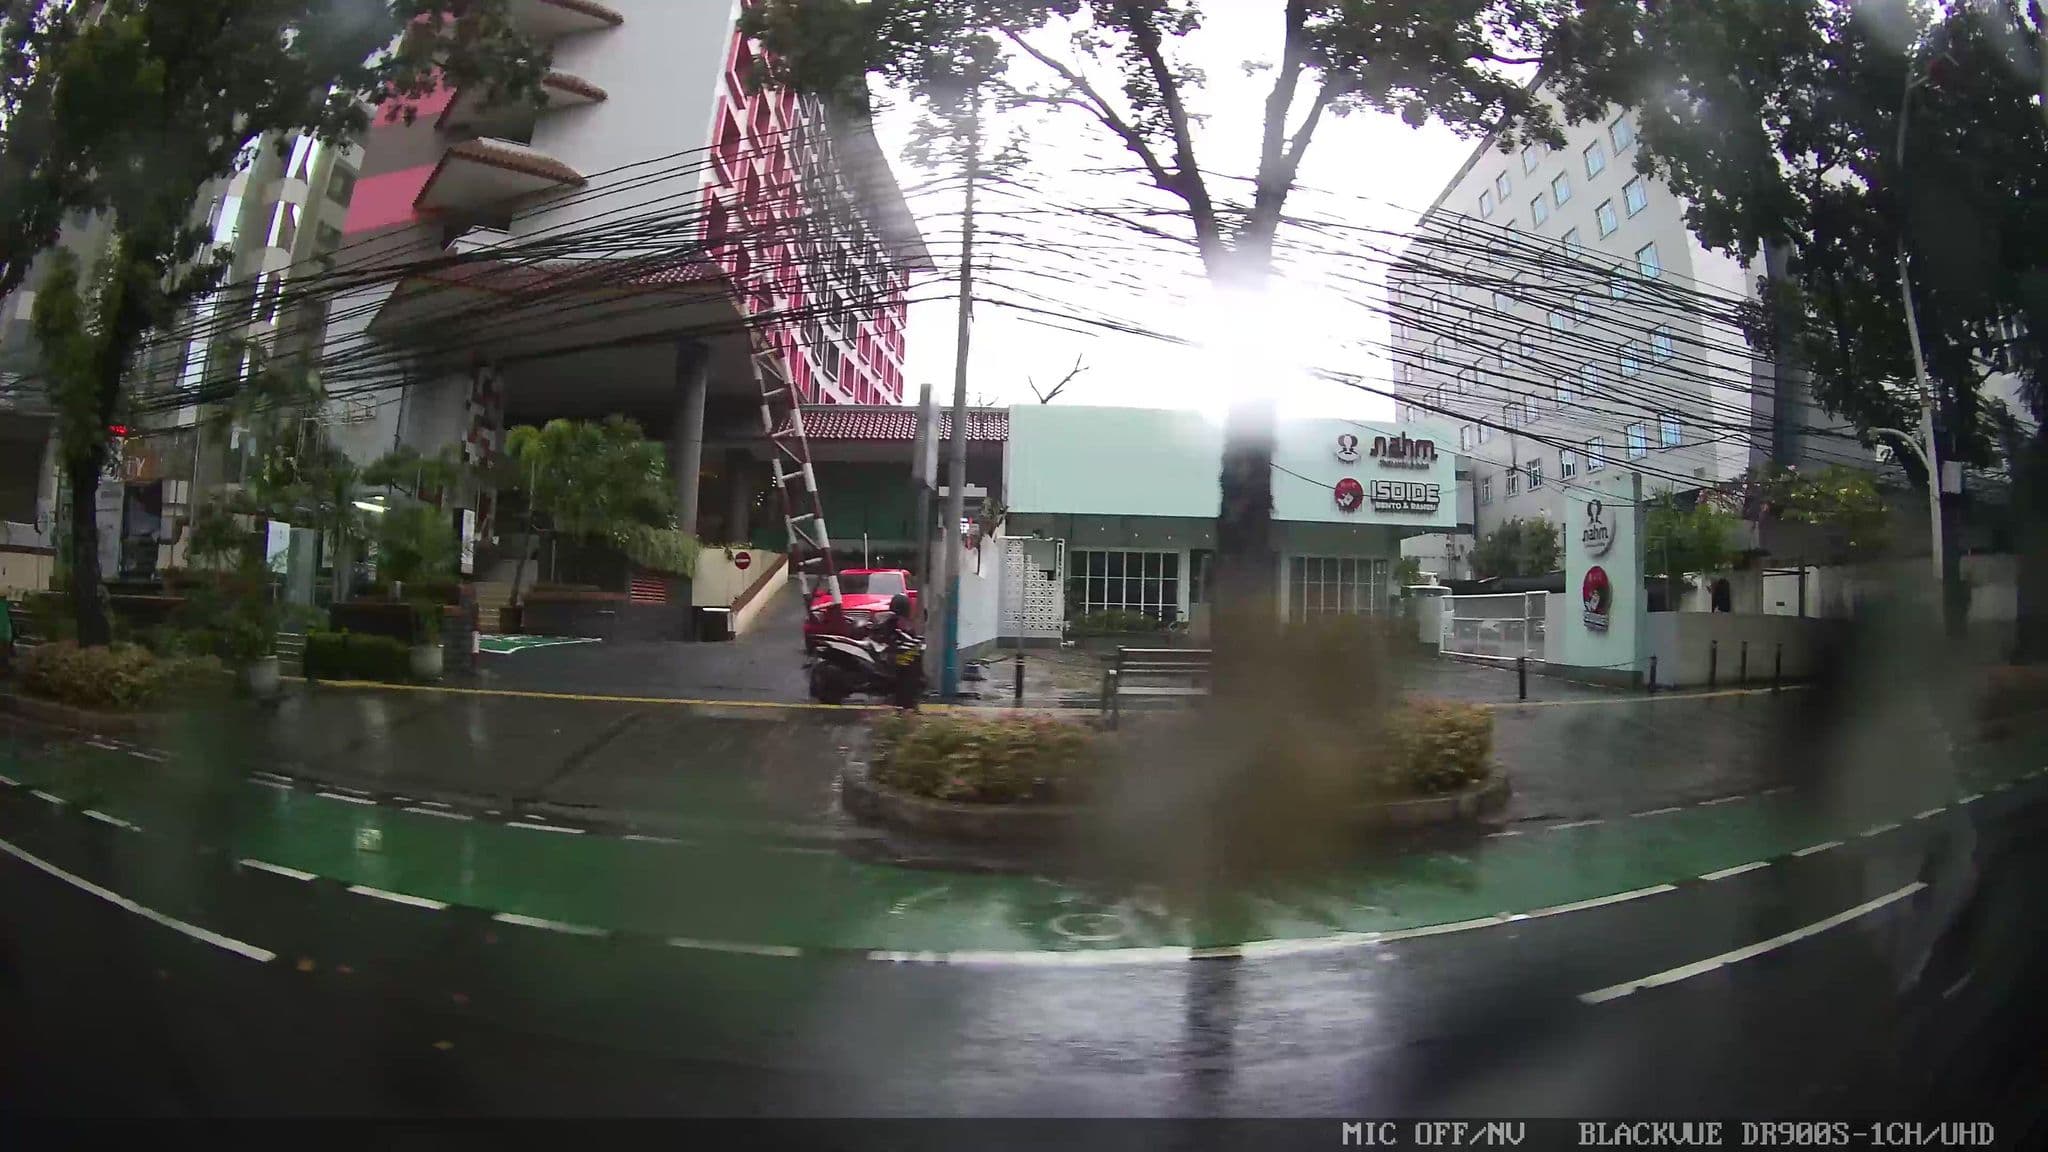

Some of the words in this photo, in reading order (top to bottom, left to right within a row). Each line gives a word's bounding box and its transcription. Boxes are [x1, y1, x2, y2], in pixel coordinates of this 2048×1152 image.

[1370, 431, 1438, 461] nahm
[1371, 480, 1440, 502] ISOIDE
[1582, 524, 1608, 541] nahm
